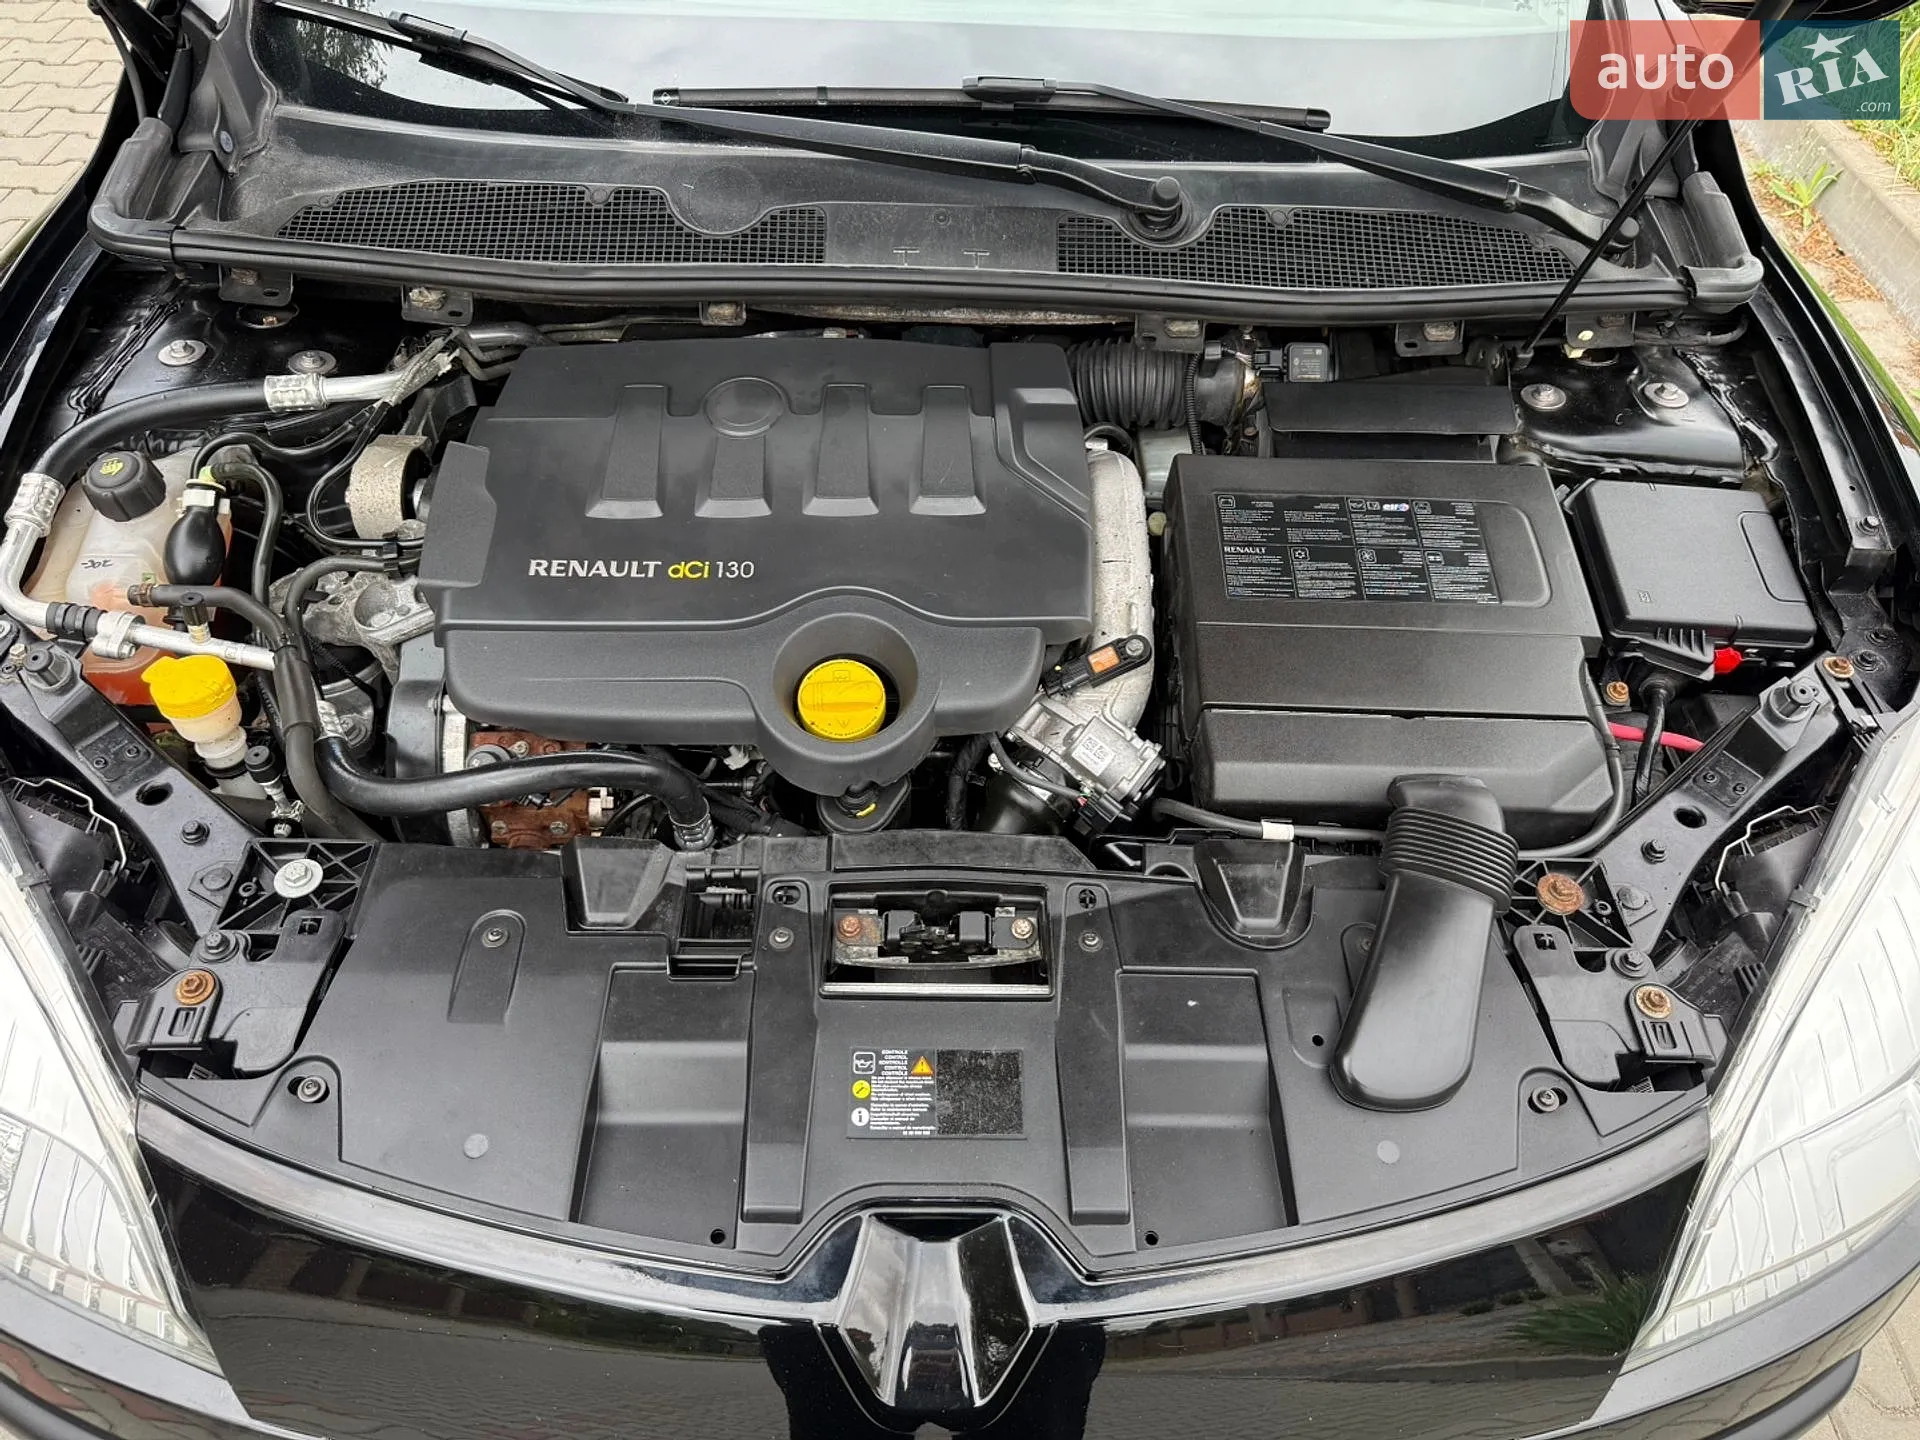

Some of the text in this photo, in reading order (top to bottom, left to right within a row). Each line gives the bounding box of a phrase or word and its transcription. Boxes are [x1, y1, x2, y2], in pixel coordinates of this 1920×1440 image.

[1223, 546, 1266, 554] RENAULT
[528, 559, 755, 579] RENAULT dCi 130
